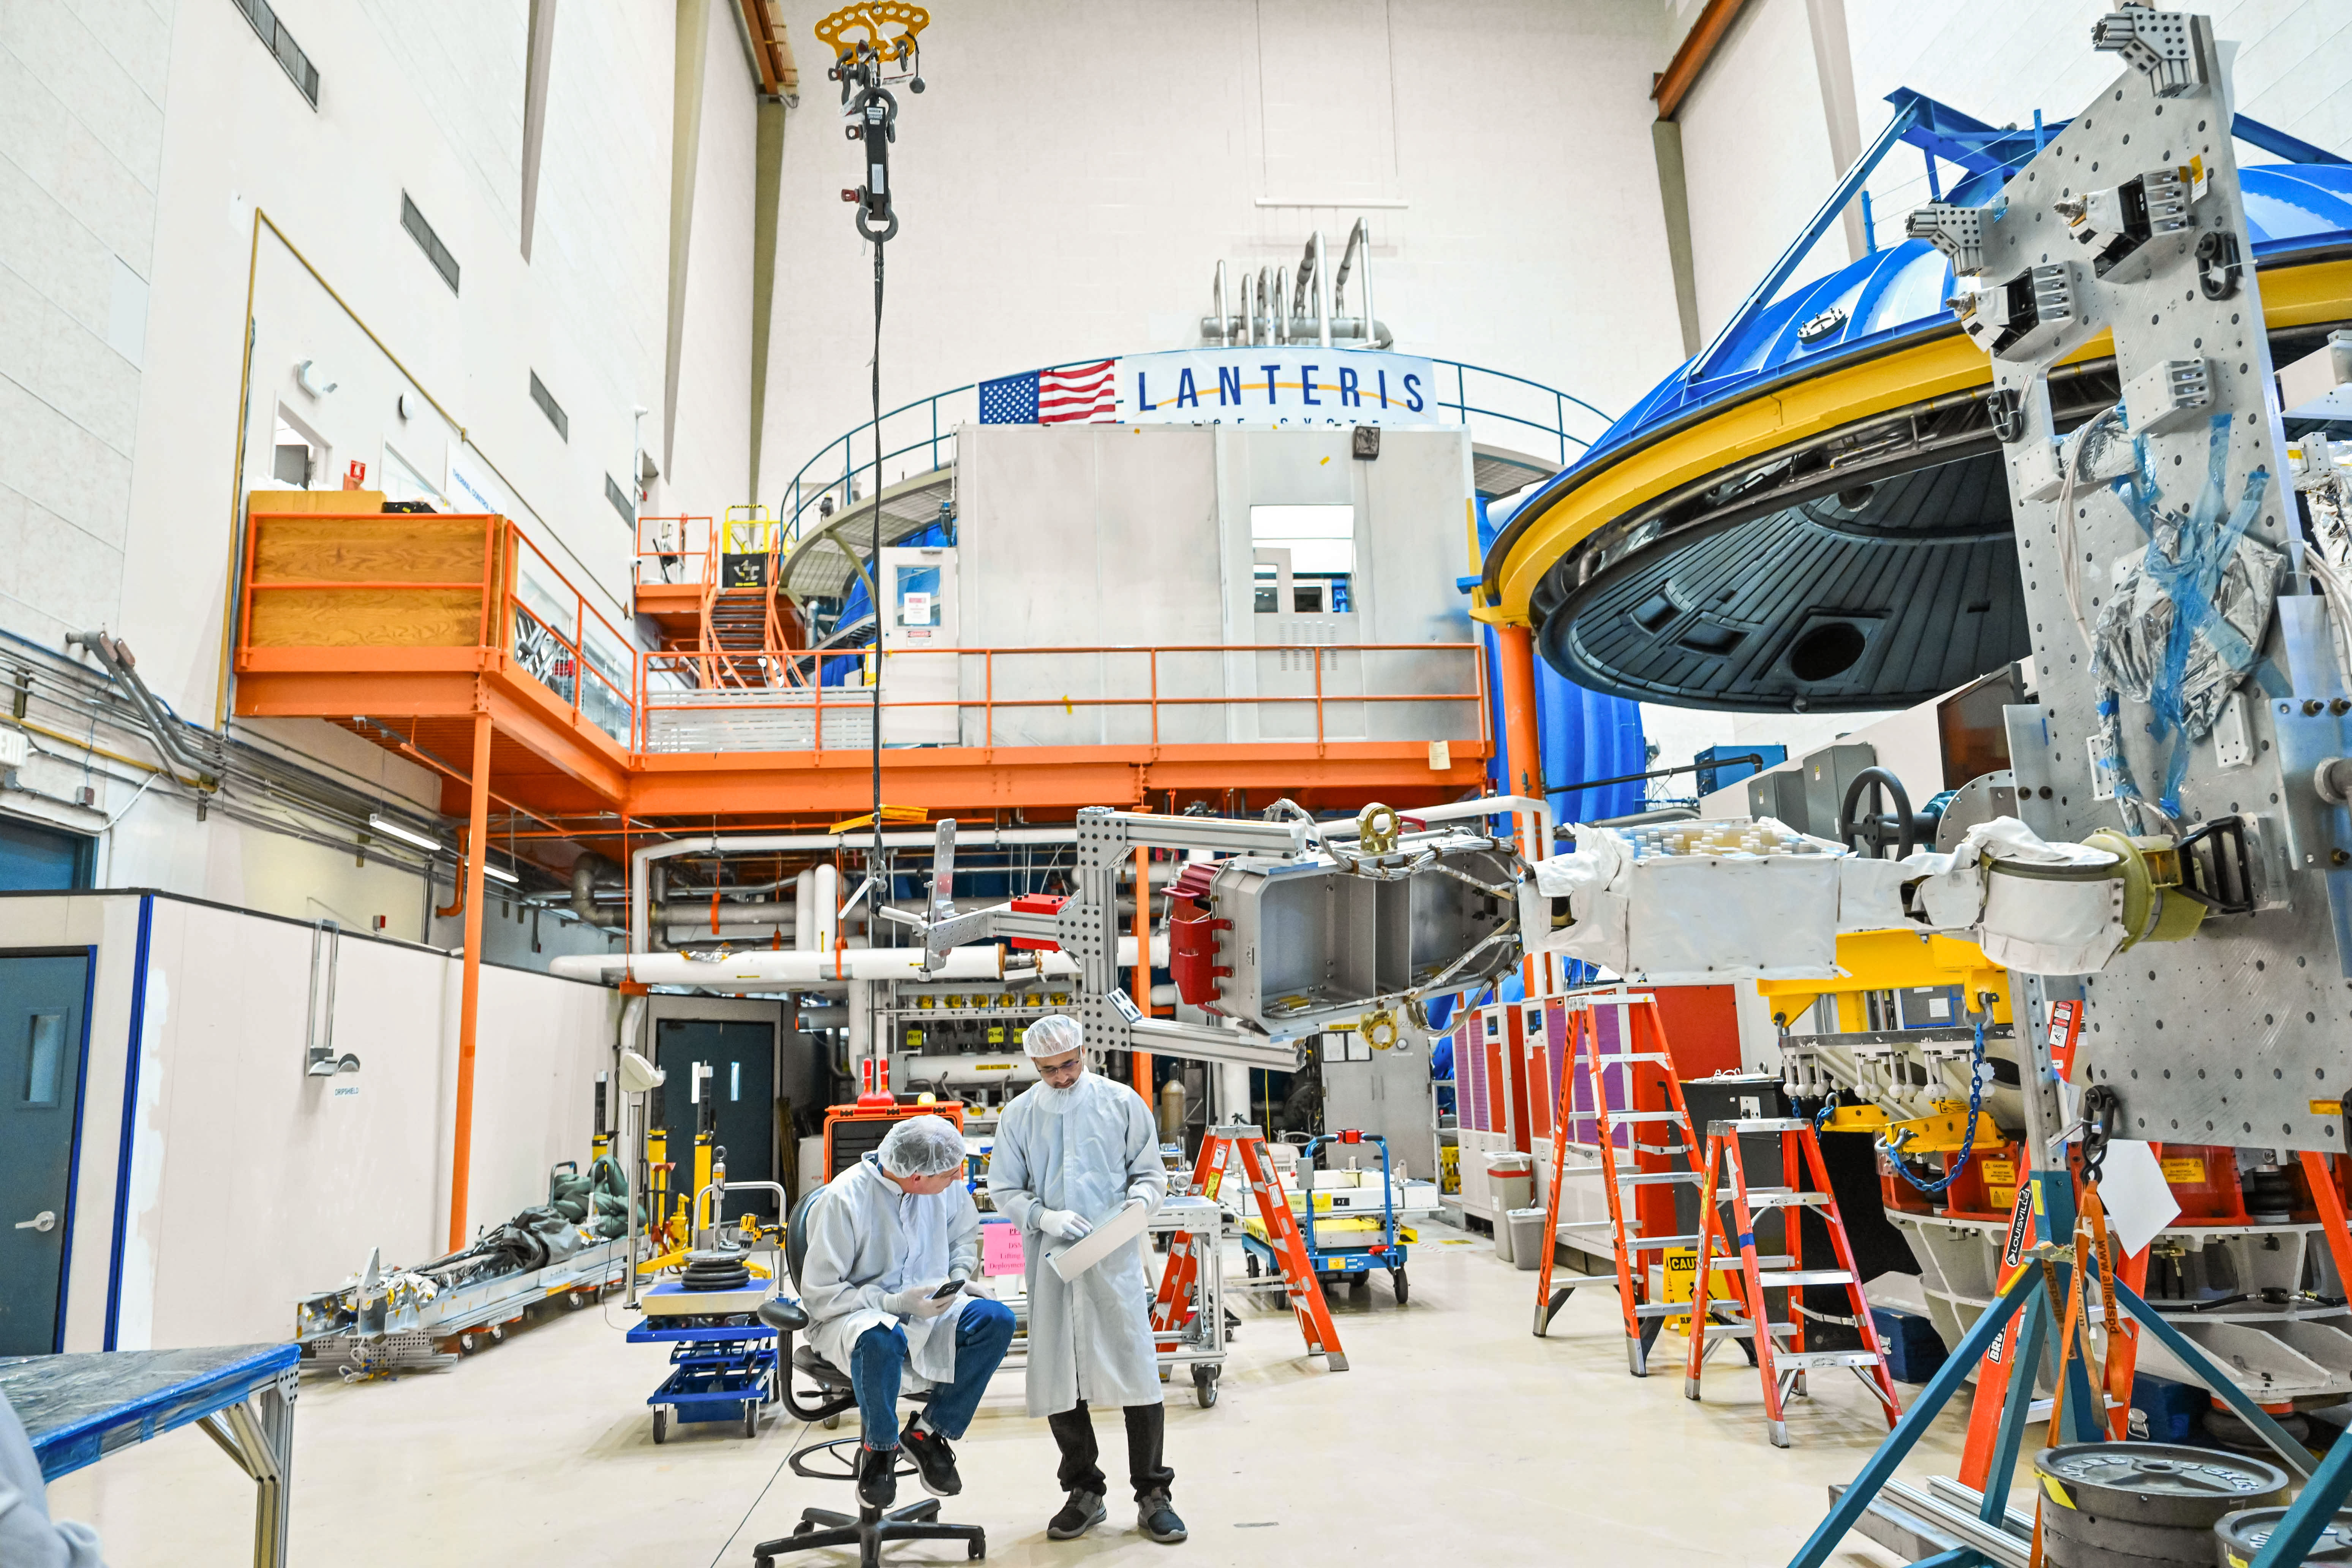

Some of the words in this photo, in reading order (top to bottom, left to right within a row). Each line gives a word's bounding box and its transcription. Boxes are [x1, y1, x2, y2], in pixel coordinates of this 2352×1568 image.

[1138, 364, 1424, 413] LANTERIS
[335, 1087, 359, 1096] DRIPSHIELD
[1671, 1258, 1696, 1270] CAU
